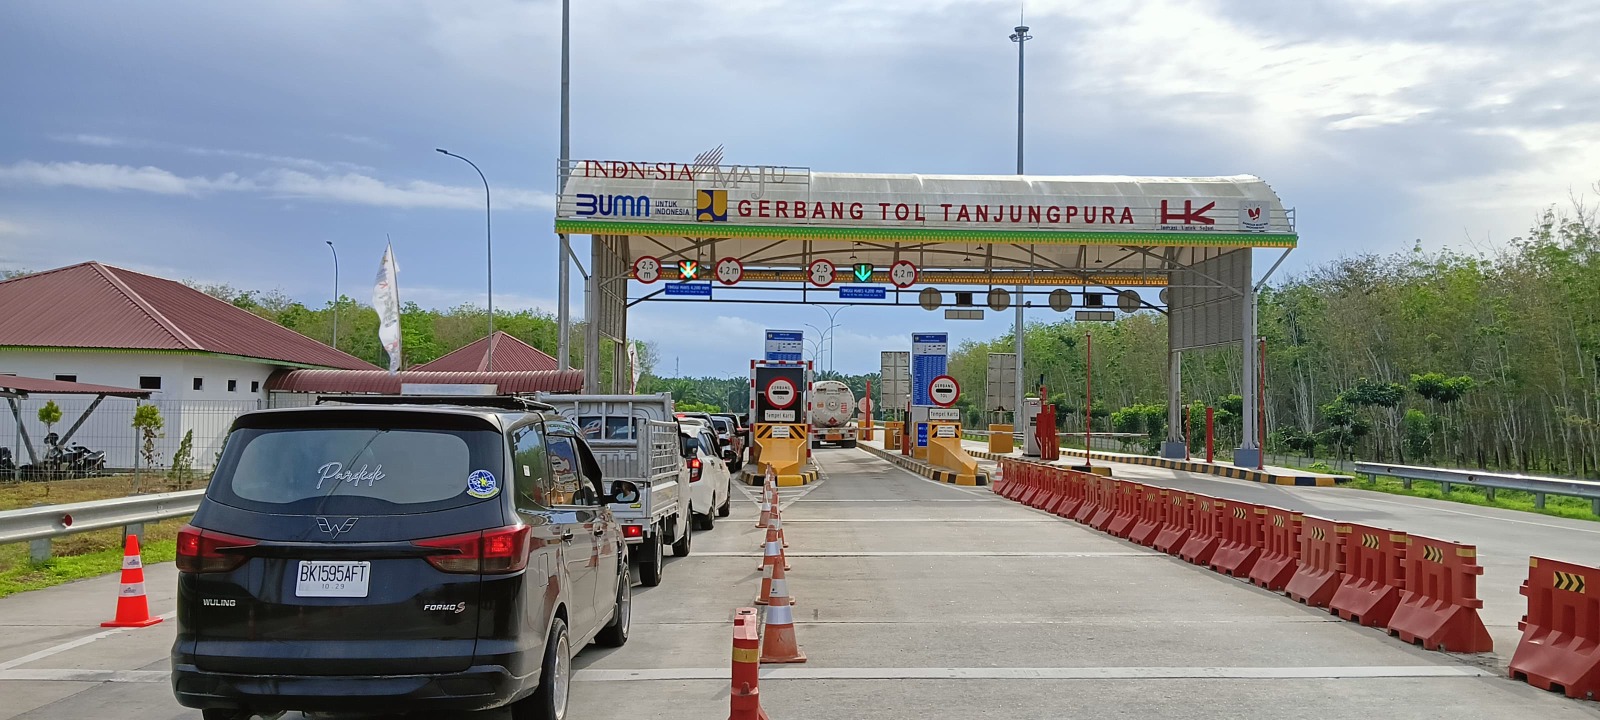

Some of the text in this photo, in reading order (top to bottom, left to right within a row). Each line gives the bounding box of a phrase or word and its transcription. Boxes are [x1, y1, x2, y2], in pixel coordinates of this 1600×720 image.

[655, 200, 678, 208] UNTUK
[654, 207, 690, 216] INDONESIA
[737, 199, 1135, 224] GERBANG TOL TANJUNGPURA
[1161, 200, 1215, 225] HK
[641, 260, 654, 271] 2,5
[816, 264, 828, 274] 2,5
[719, 266, 730, 276] 4,2
[894, 270, 905, 279] 4,2
[203, 598, 236, 607] WULING
[454, 601, 466, 614] S
